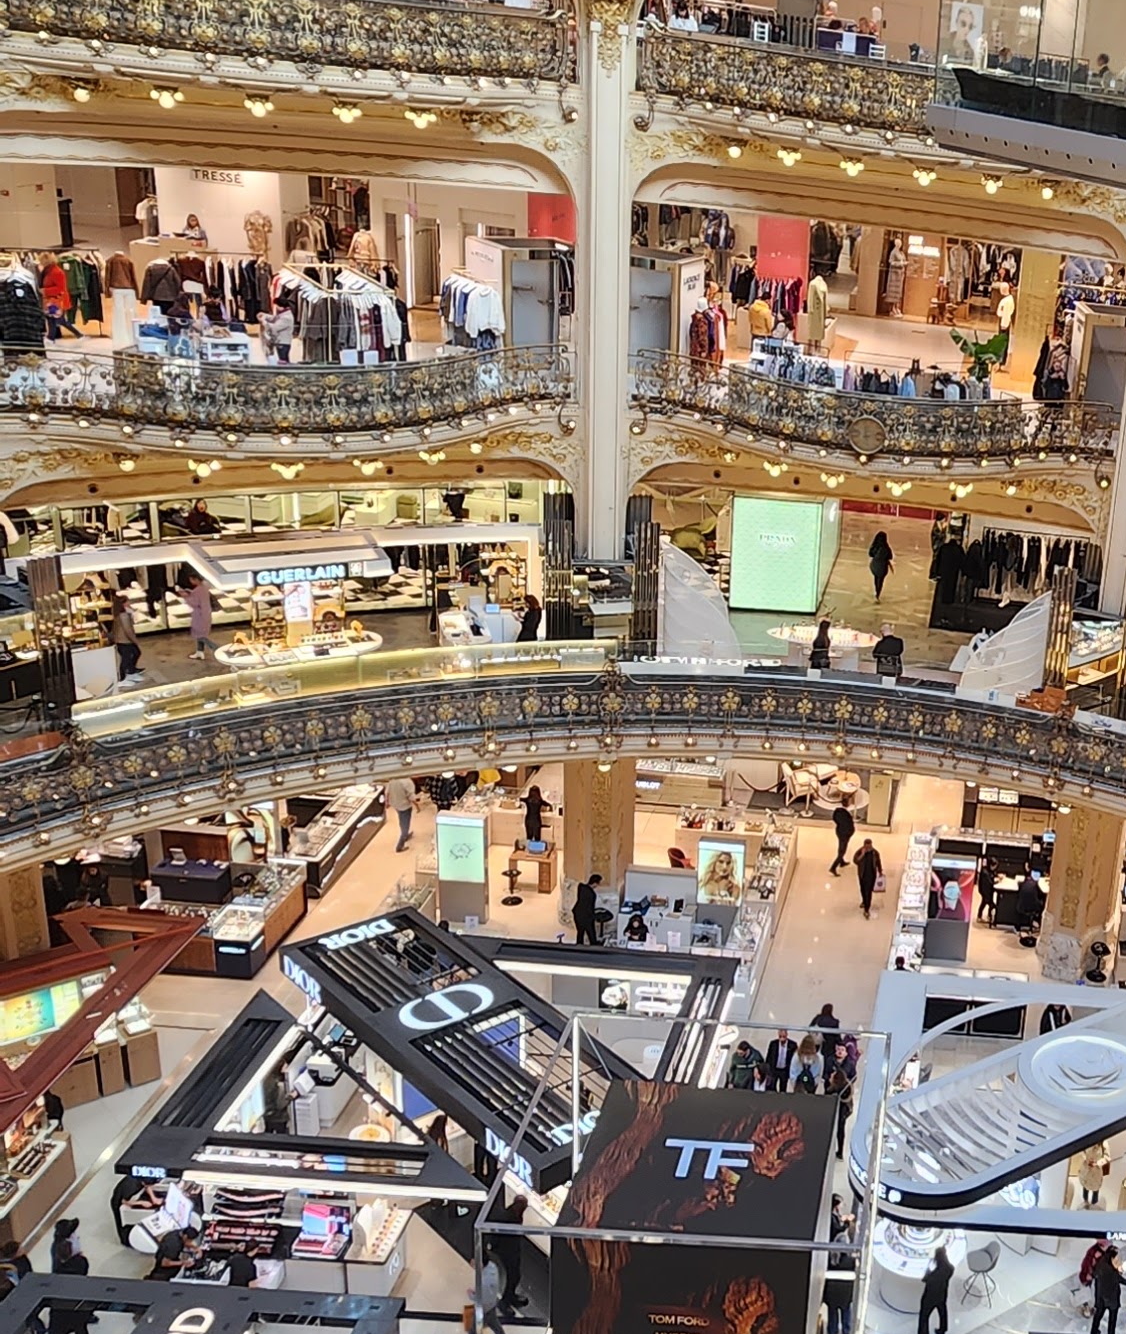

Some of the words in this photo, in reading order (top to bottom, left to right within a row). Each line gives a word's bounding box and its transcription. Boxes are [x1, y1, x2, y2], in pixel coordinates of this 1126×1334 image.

[191, 168, 243, 184] TRESSÉ
[256, 564, 346, 585] GUERLAIN
[635, 780, 661, 790] UBLOT
[317, 918, 397, 950] DIOR
[283, 954, 322, 1005] DIOR
[550, 1110, 601, 1147] DIO
[485, 1127, 534, 1188] DIOR
[664, 1138, 755, 1180] TF
[131, 1165, 166, 1178] DIOR
[648, 1314, 675, 1325] TOM
[676, 1316, 710, 1327] FORD
